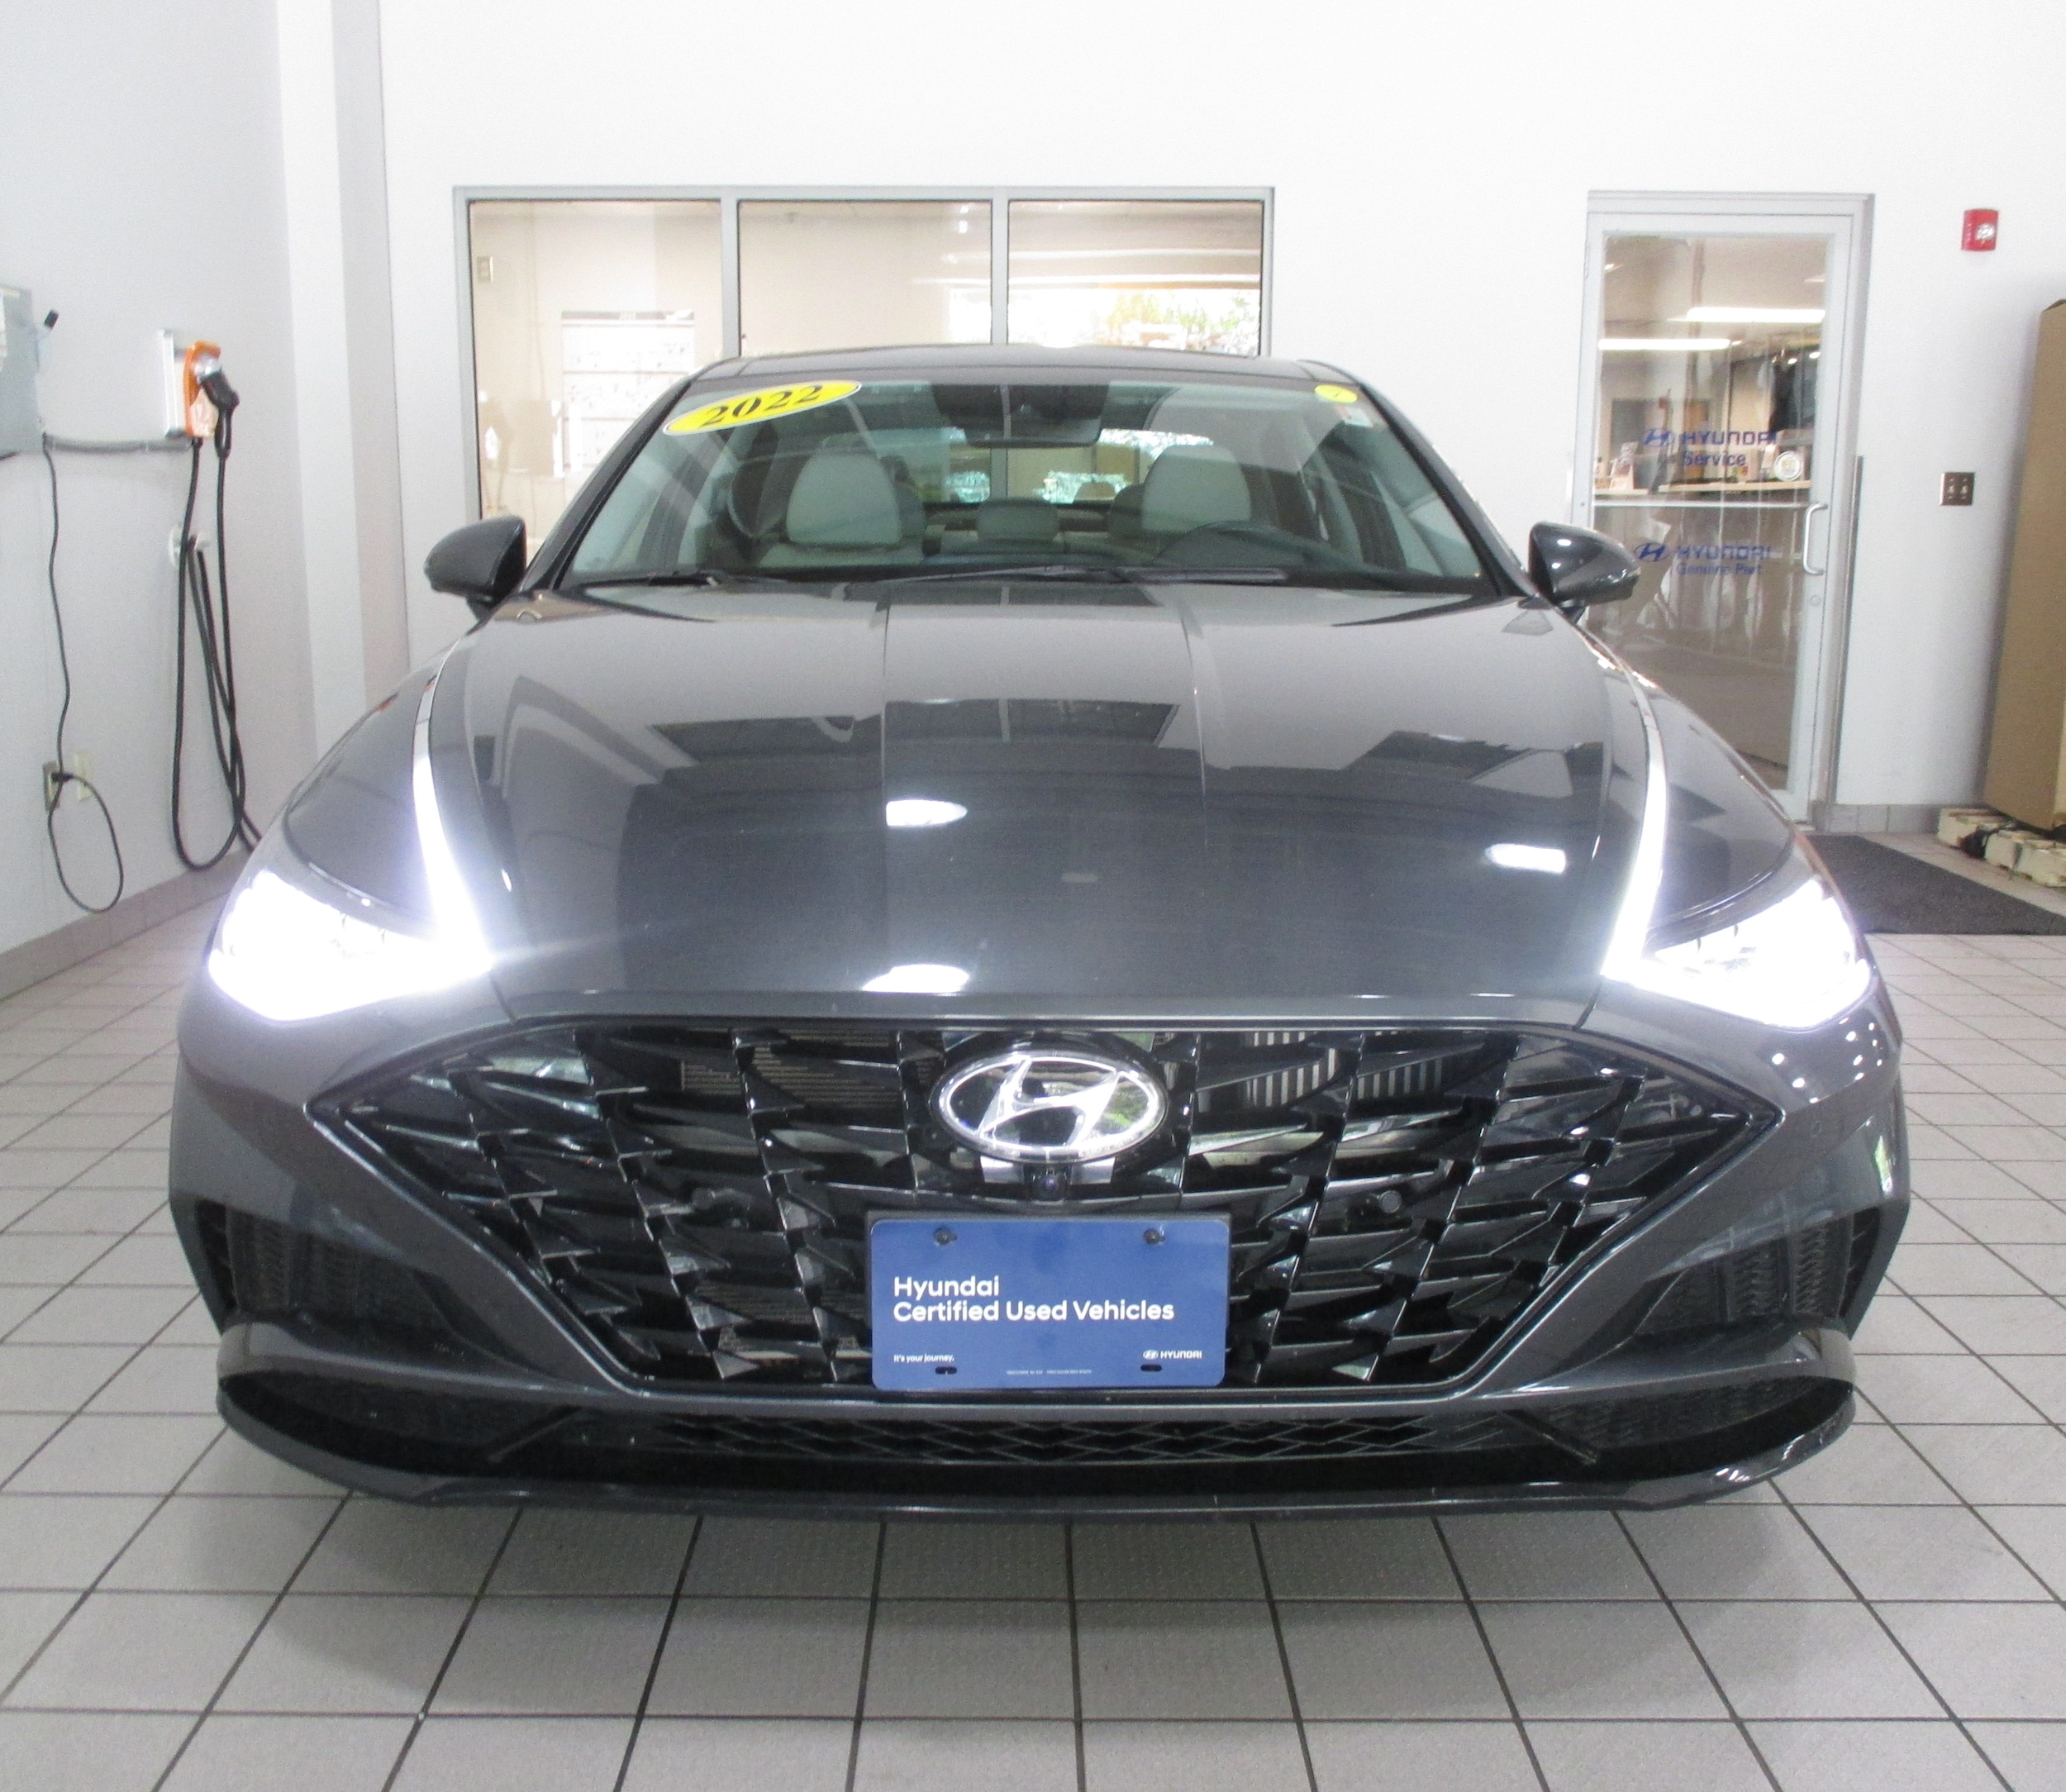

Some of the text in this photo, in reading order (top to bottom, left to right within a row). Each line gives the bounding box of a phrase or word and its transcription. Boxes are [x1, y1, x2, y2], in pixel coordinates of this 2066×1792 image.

[700, 384, 823, 428] 2022
[1682, 431, 1776, 445] HYUNDAI
[1684, 450, 1746, 465] Service
[1677, 546, 1771, 560] HYUNDAI
[893, 1275, 1000, 1300] Hyundai
[893, 1299, 1174, 1322] Certified Used Vehicles
[906, 1354, 923, 1364] your
[1160, 1350, 1202, 1359] HYUNDAI
